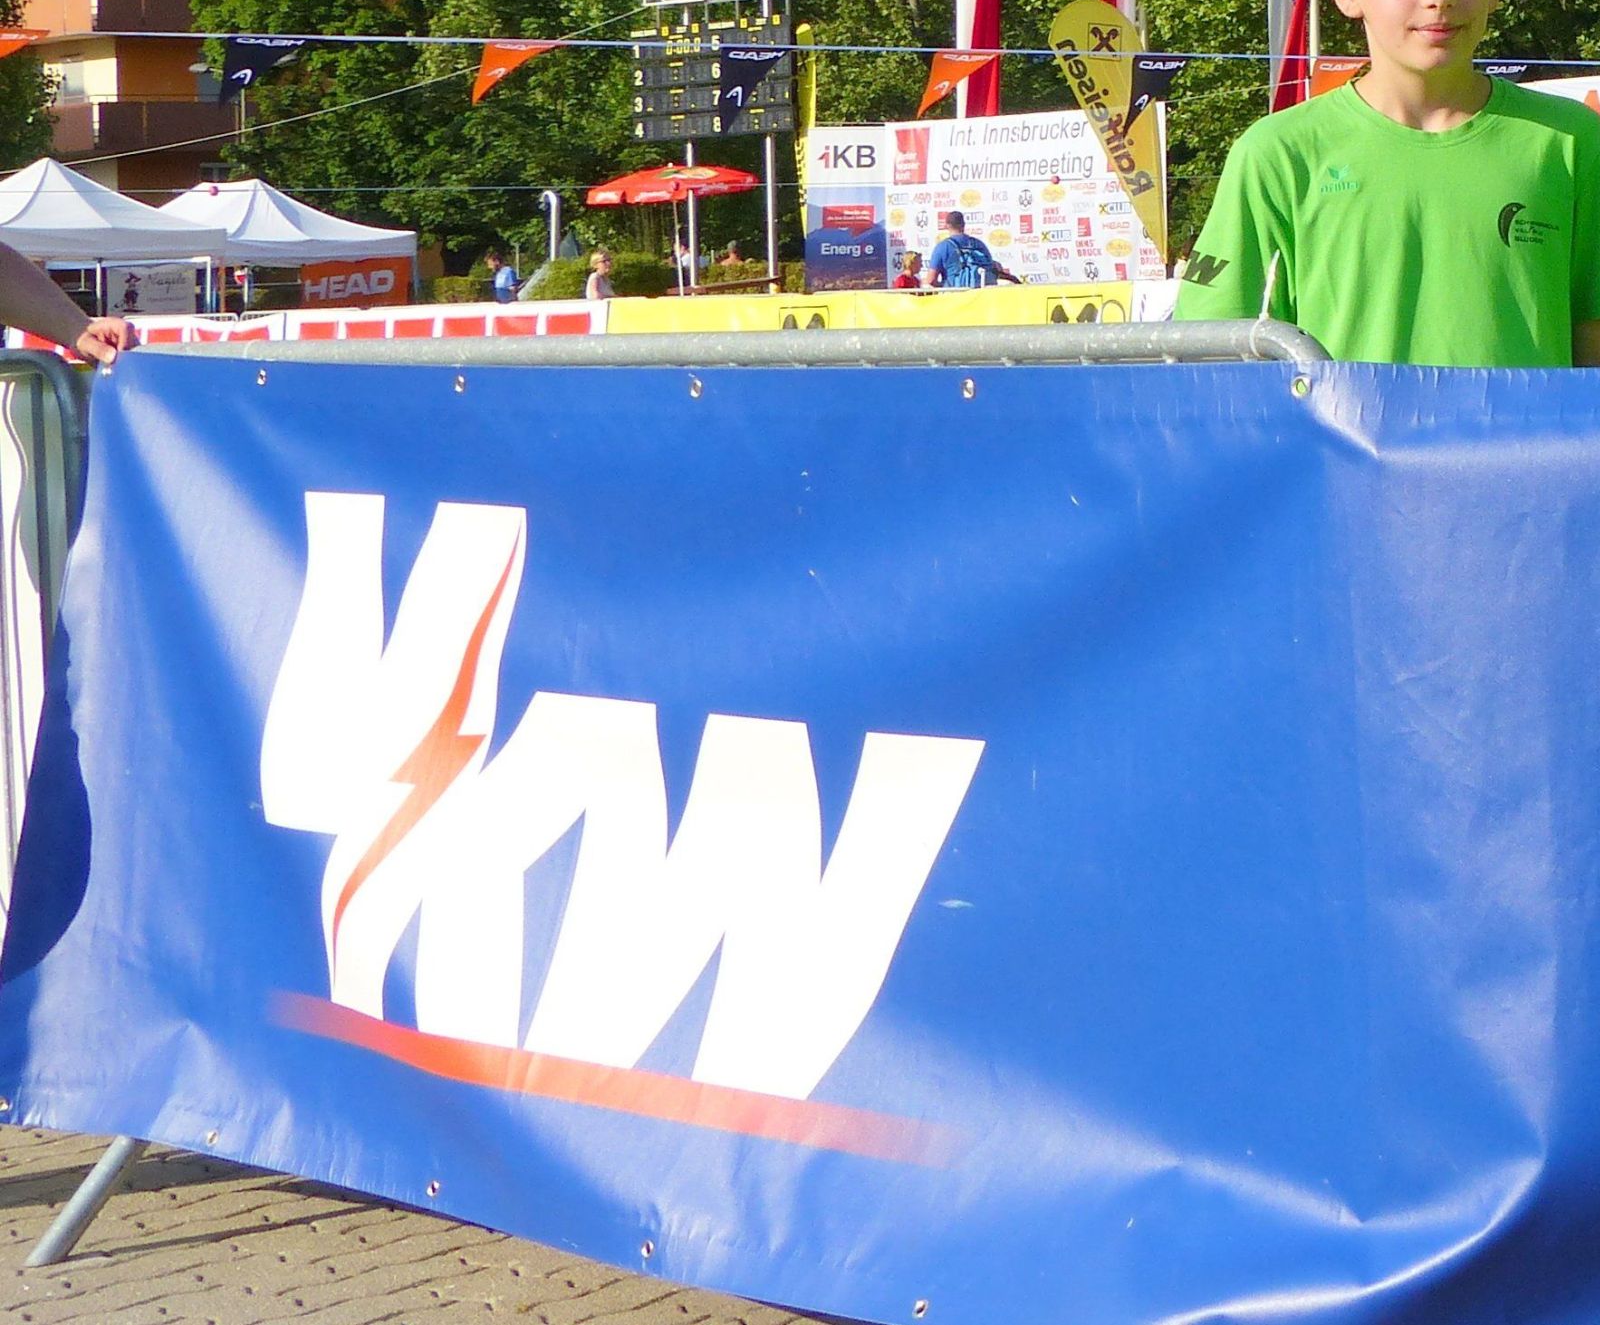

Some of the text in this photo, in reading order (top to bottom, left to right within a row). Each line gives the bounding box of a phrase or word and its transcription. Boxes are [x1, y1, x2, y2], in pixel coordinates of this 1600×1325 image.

[633, 62, 721, 87] 2 6
[634, 89, 721, 113] 3 7
[712, 116, 722, 133] 8
[949, 118, 1089, 147] Int. Innsbrucker
[817, 144, 877, 169] iKB
[304, 270, 395, 303] HEAD
[259, 490, 986, 1101] VKW
